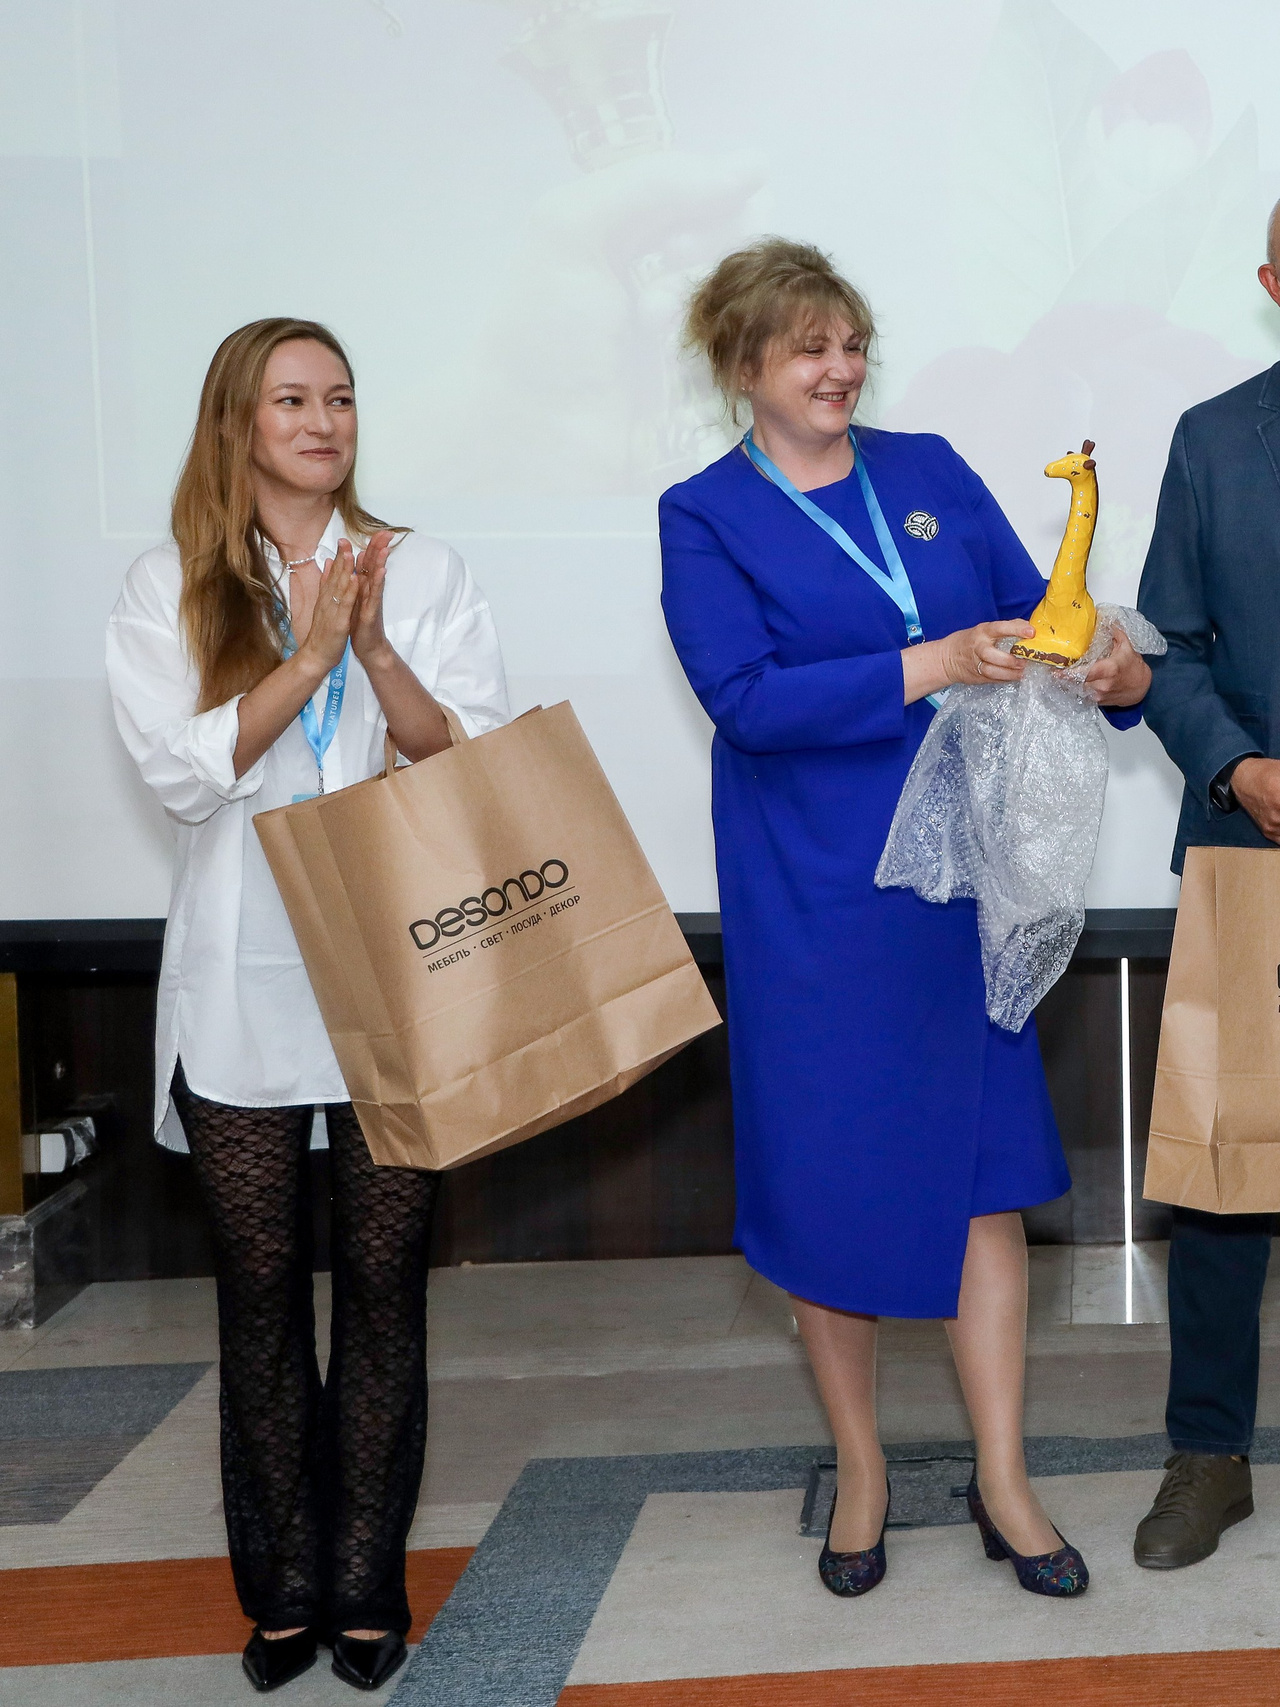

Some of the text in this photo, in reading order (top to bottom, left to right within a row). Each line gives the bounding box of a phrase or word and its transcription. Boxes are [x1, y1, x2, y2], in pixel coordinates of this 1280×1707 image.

[427, 895, 581, 973] МЕБЕЛЬ СВЕТ ПОСУДА ДЕКОР
